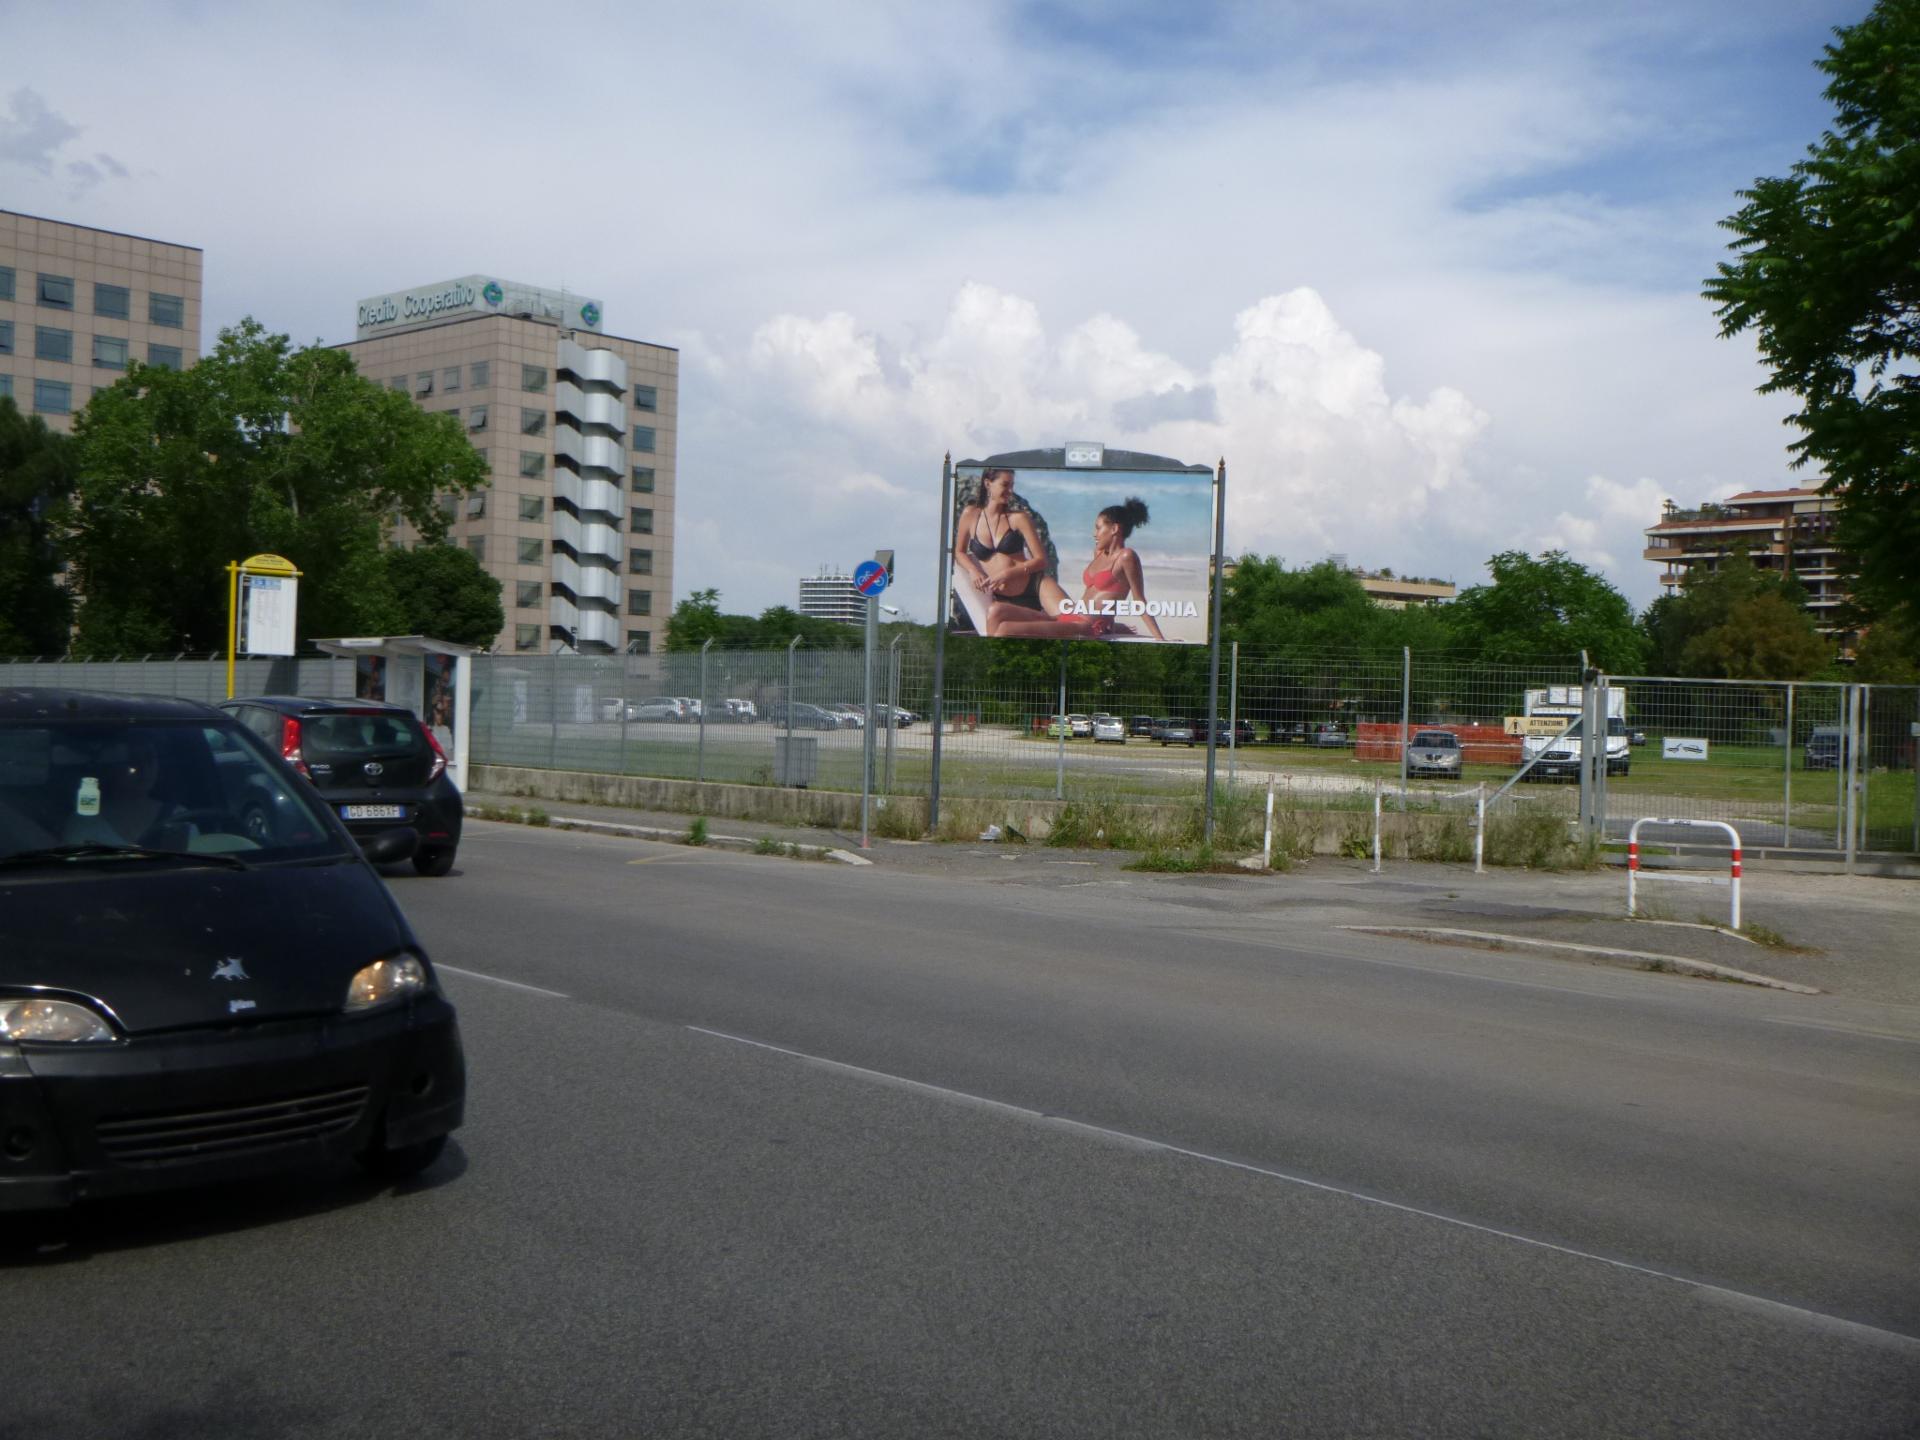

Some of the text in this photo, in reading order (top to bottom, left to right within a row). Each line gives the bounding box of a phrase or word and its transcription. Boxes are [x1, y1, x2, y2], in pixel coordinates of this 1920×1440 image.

[358, 283, 475, 328] Credito Cooperativo
[1059, 598, 1198, 617] CALZEDONIA
[1530, 719, 1564, 727] ATTENZIONE
